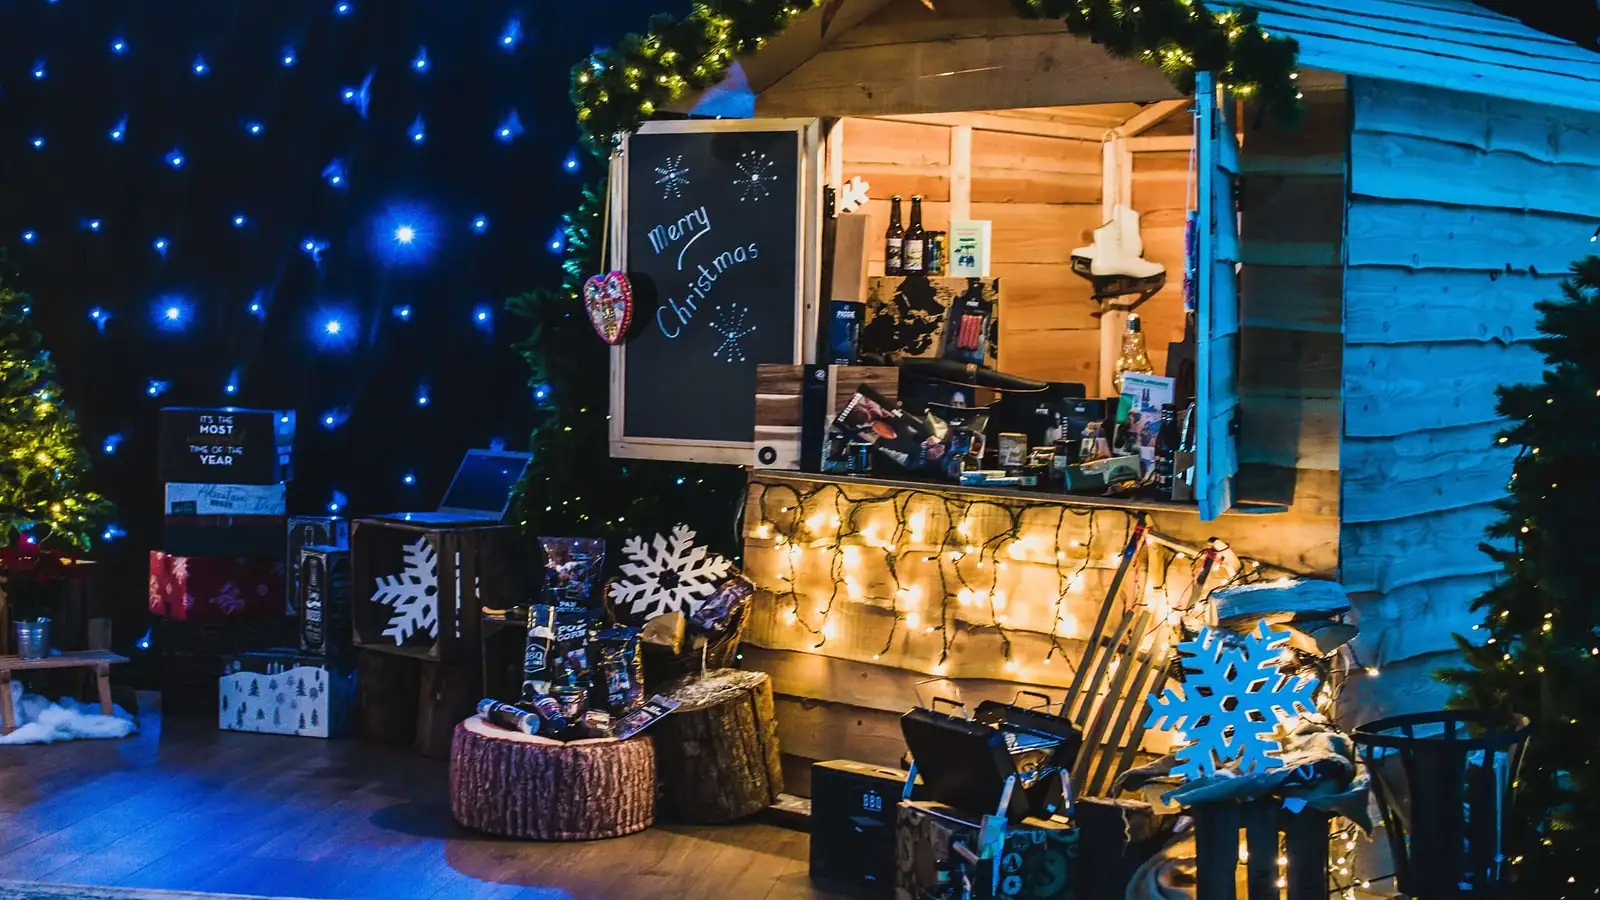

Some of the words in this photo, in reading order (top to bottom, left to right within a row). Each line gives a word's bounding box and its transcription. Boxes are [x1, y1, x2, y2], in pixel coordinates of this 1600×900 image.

[647, 206, 711, 270] Merry
[656, 242, 759, 338] Christmas
[218, 415, 234, 425] THE
[199, 424, 234, 435] MOST
[189, 445, 209, 454] TIME
[211, 445, 225, 454] OF
[227, 446, 245, 456] THE
[199, 454, 233, 466] YEAR
